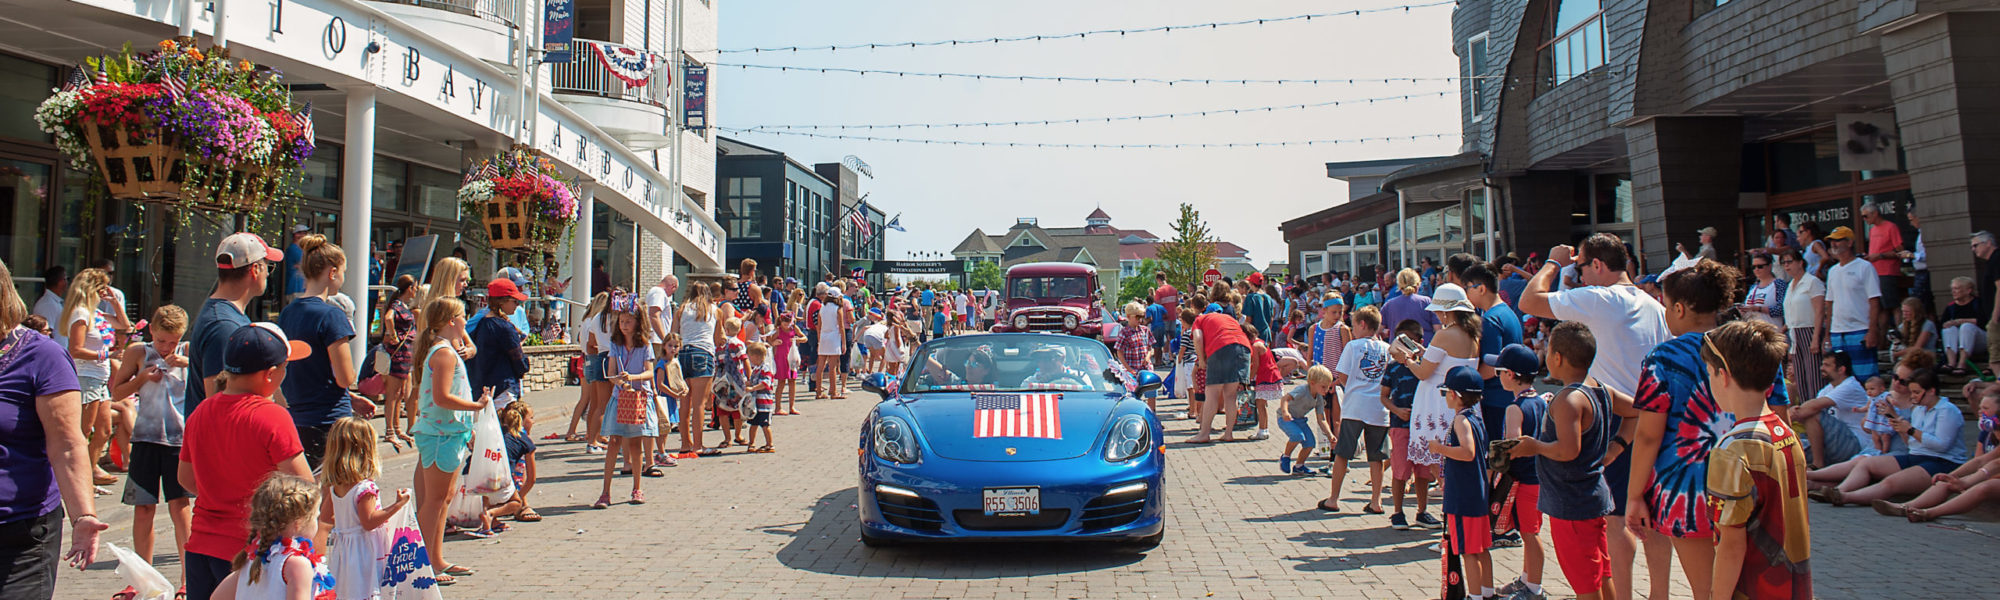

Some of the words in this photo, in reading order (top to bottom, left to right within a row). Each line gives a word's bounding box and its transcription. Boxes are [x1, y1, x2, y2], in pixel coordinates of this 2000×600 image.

[407, 46, 486, 109] BAY
[522, 119, 652, 204] ARBOR
[1818, 207, 1850, 223] PASTRIES
[1205, 274, 1220, 282] STOP
[985, 496, 1006, 511] R55
[1012, 496, 1038, 511] 3506
[392, 547, 417, 565] trvel
